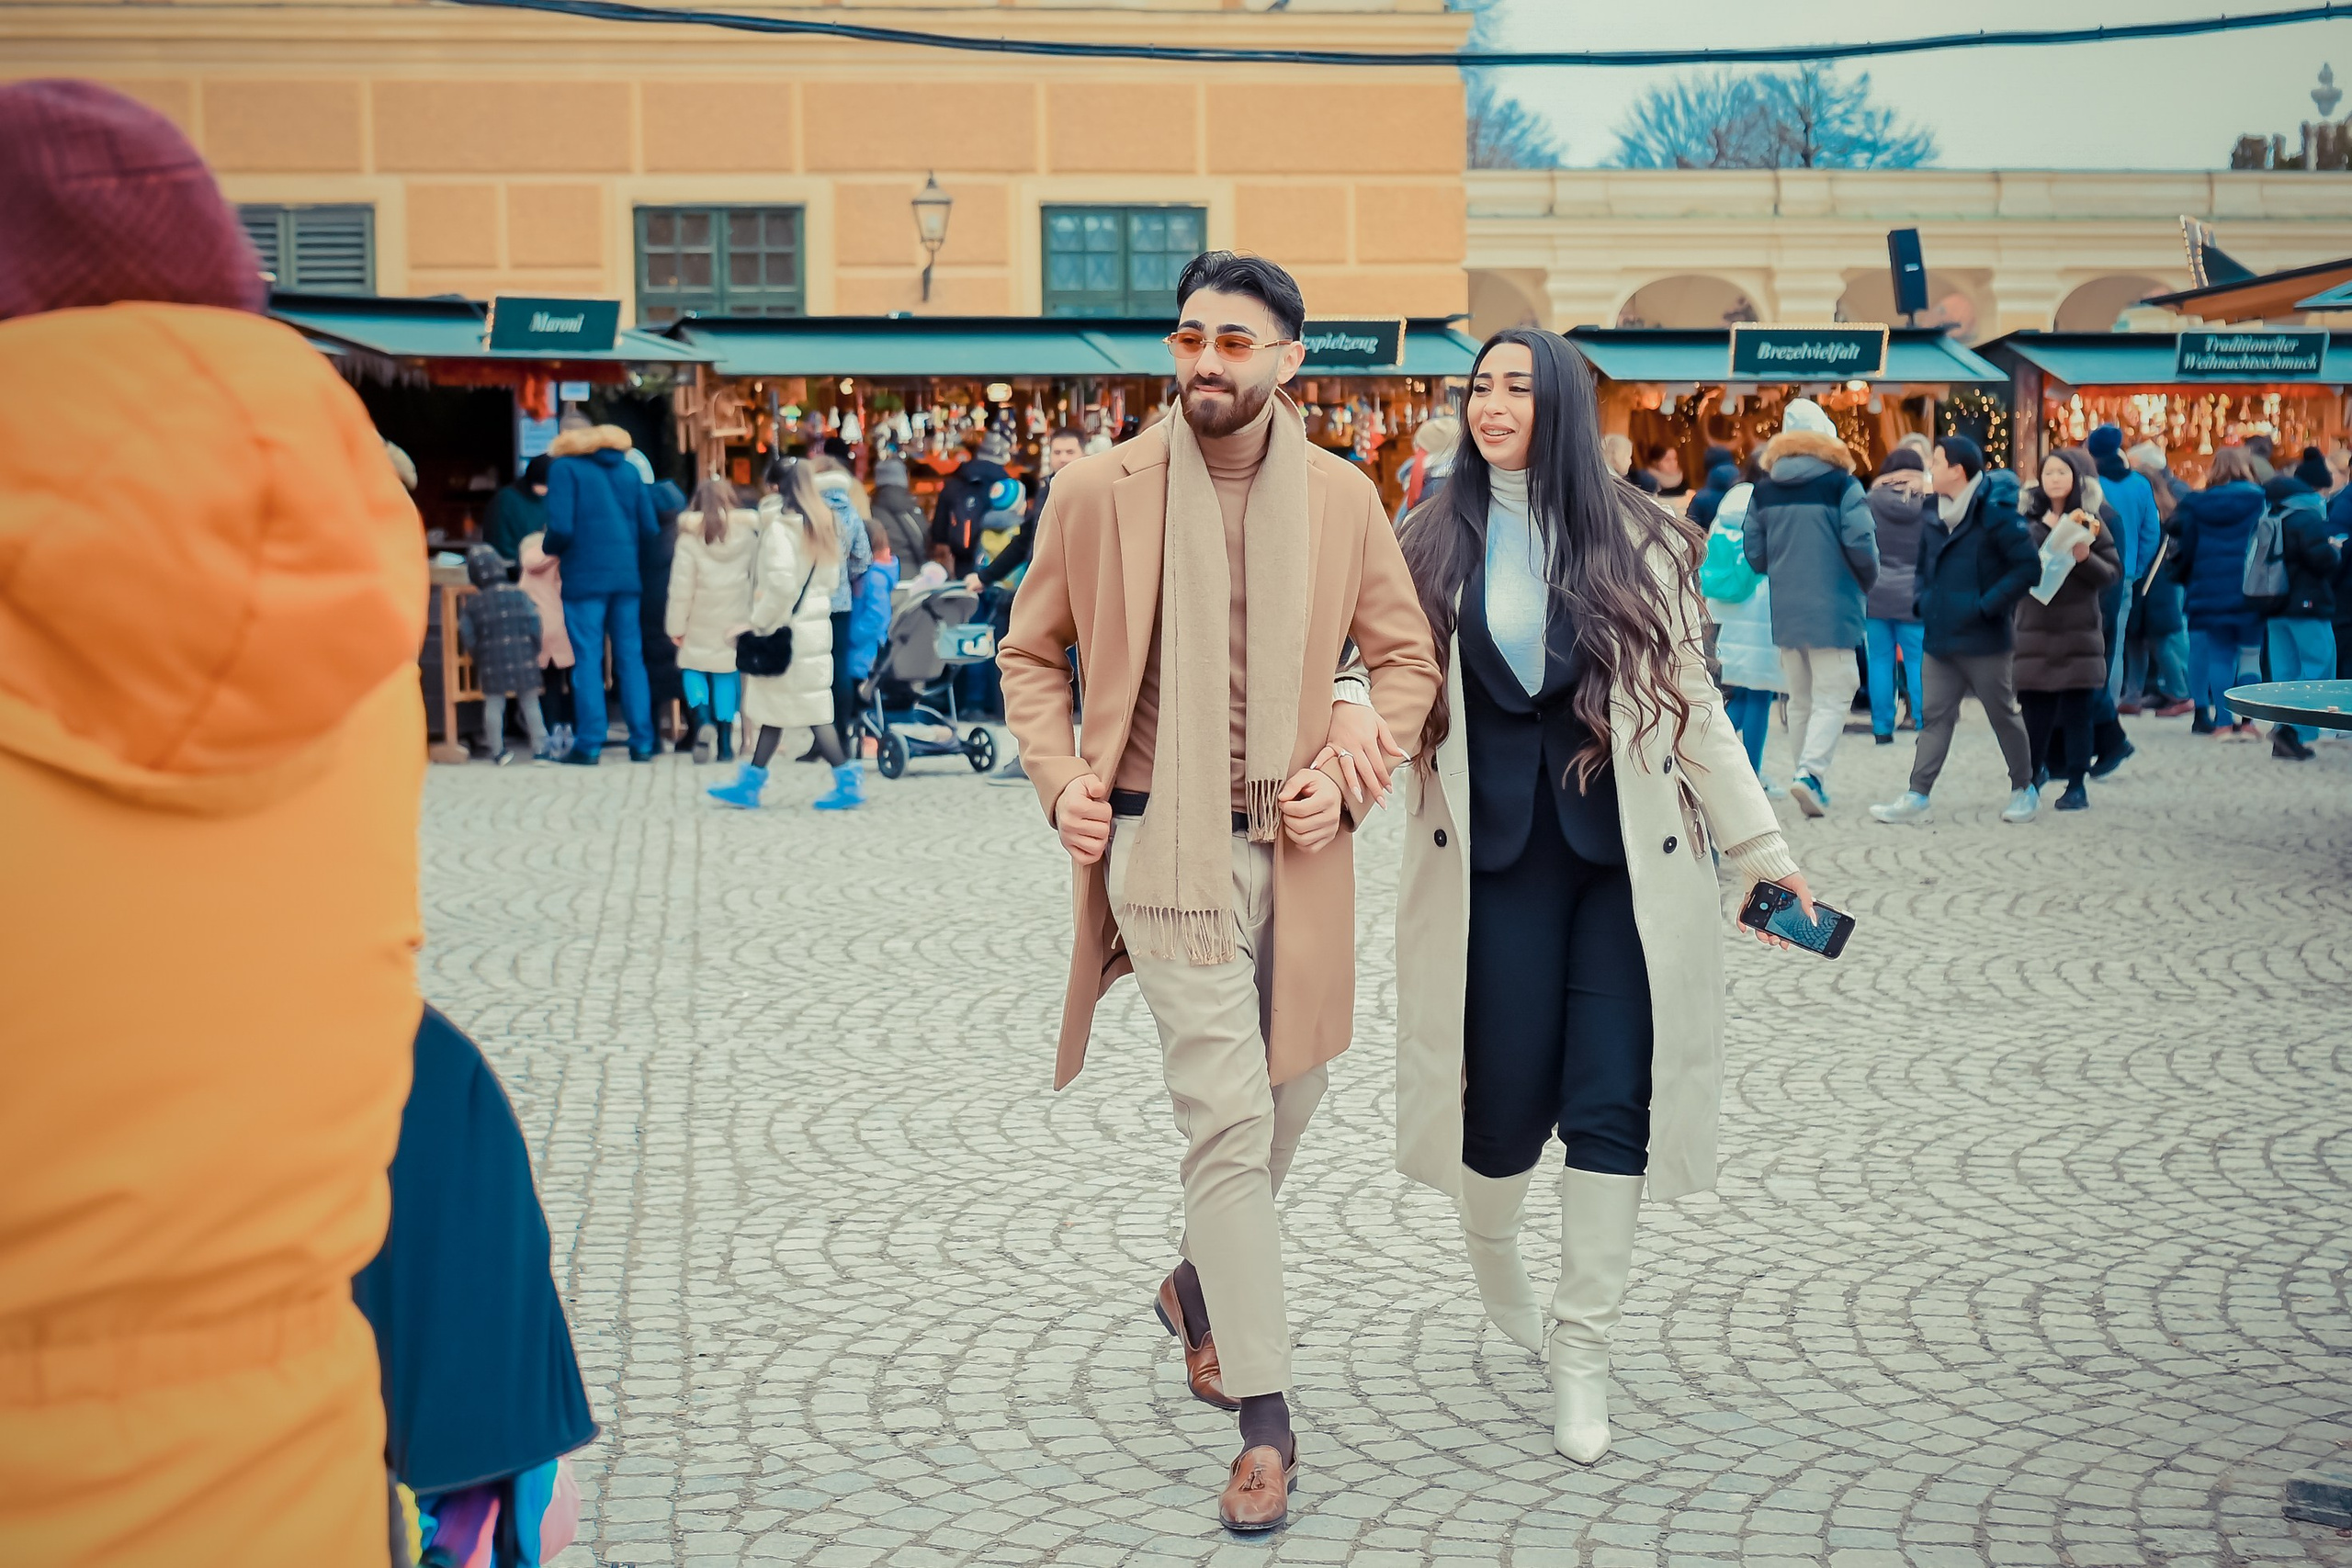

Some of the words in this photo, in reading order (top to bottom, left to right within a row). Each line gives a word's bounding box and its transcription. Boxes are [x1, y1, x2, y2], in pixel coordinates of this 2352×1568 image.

[528, 310, 585, 333] Maroni
[1757, 341, 1860, 363] Brezelvielfalt
[2205, 334, 2300, 353] Traditioneller
[2183, 353, 2318, 370] Weihnachtsschmuck
